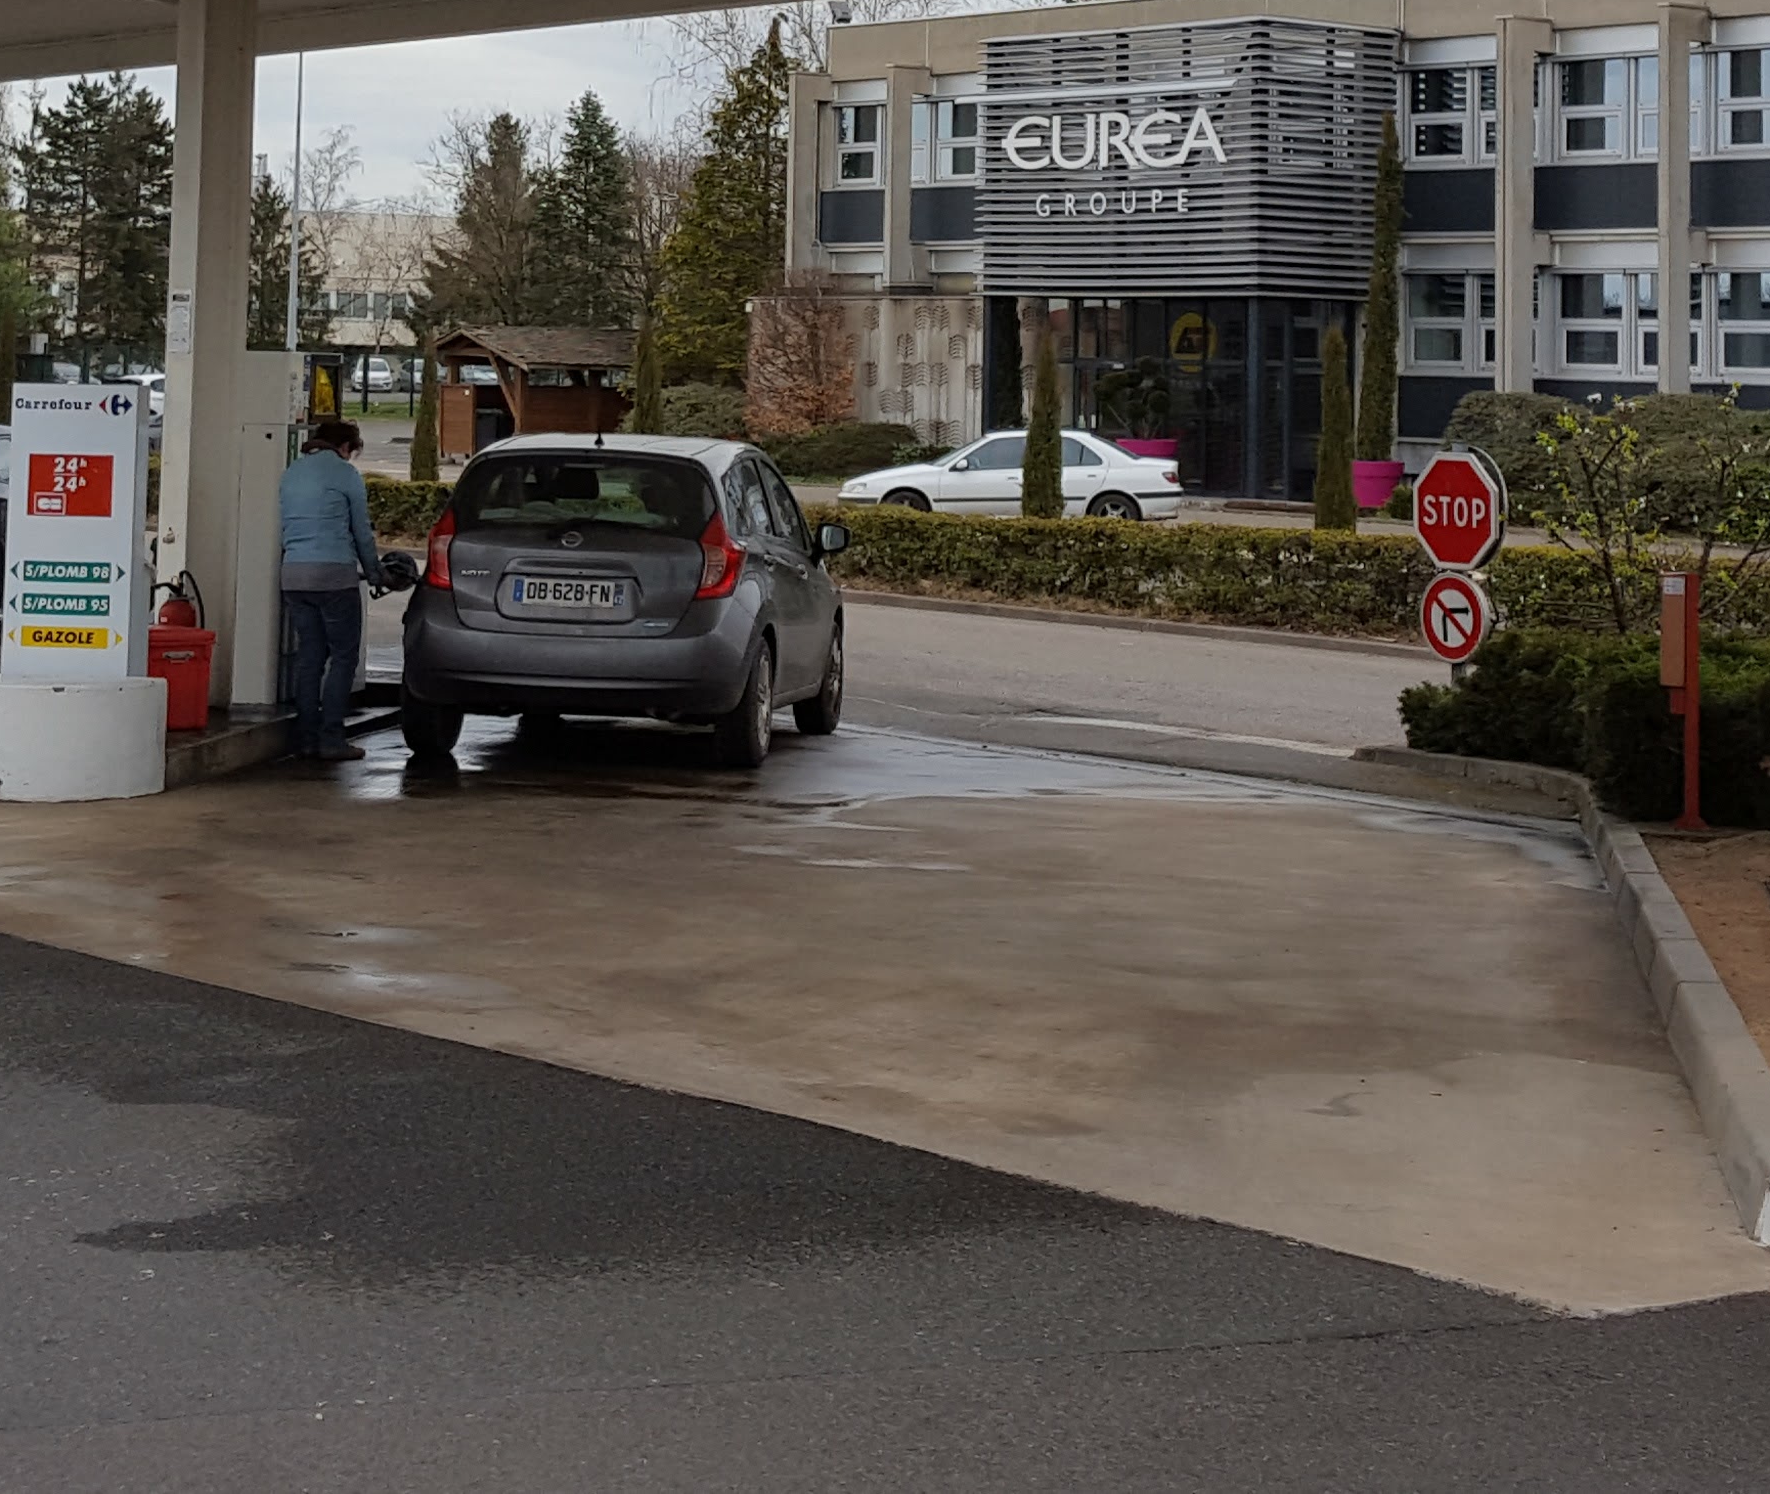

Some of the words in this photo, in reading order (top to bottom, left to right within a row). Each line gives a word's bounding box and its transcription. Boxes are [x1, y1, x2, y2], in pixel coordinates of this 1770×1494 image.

[1001, 107, 1227, 170] EUREA
[1035, 188, 1190, 217] GROUPE
[15, 398, 92, 410] Carrefour
[54, 457, 87, 473] 24h
[53, 476, 87, 492] 24h
[1423, 494, 1486, 528] STOP
[25, 564, 88, 578] S/PLOMB
[92, 566, 109, 579] 98
[23, 596, 88, 611] S/PLOMB
[91, 598, 108, 612] 95
[32, 630, 95, 645] GAZOLE
